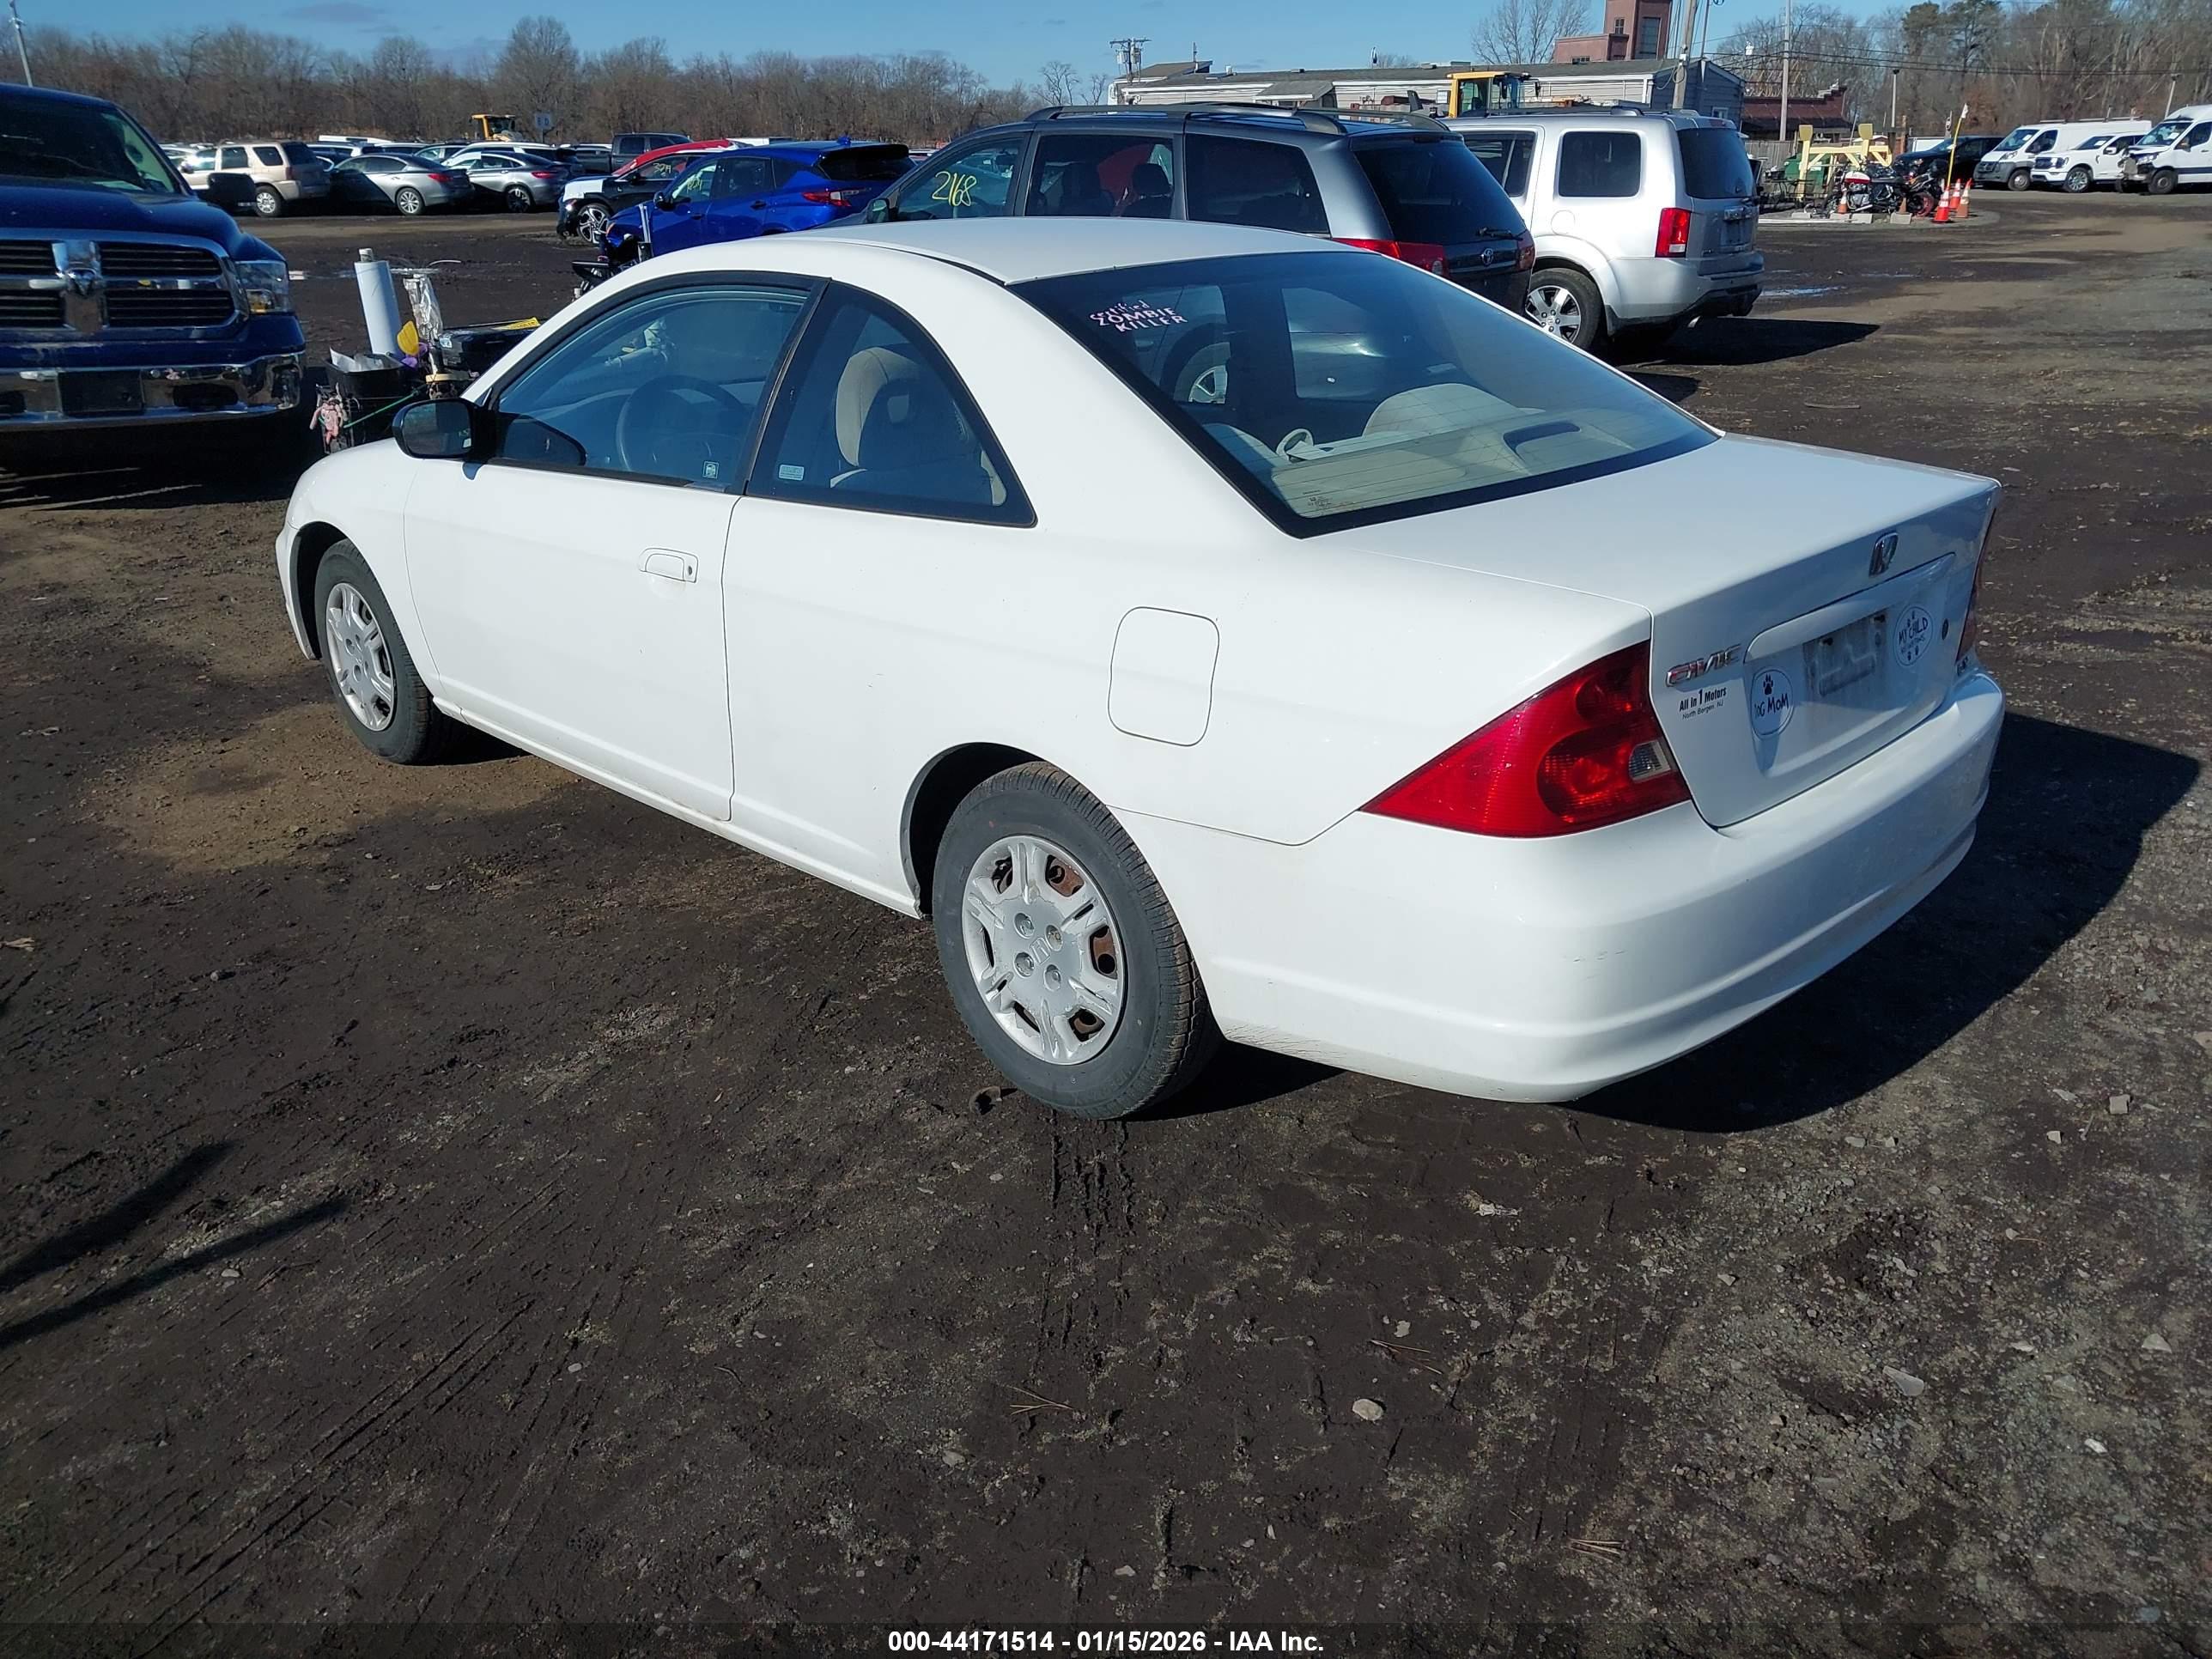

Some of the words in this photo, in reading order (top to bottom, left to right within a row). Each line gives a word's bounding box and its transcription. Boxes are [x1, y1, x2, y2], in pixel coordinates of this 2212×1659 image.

[932, 169, 977, 206] 2168
[1090, 300, 1151, 320] Certified
[1094, 307, 1176, 326] ZOMBIE
[1115, 315, 1188, 332] KILLER
[1909, 617, 1929, 640] CHILD
[1665, 642, 1741, 687] CIVIC
[1679, 698, 1689, 713] All
[1698, 690, 1704, 704] 1
[1705, 687, 1727, 703] Motors
[1682, 711, 1696, 720] North
